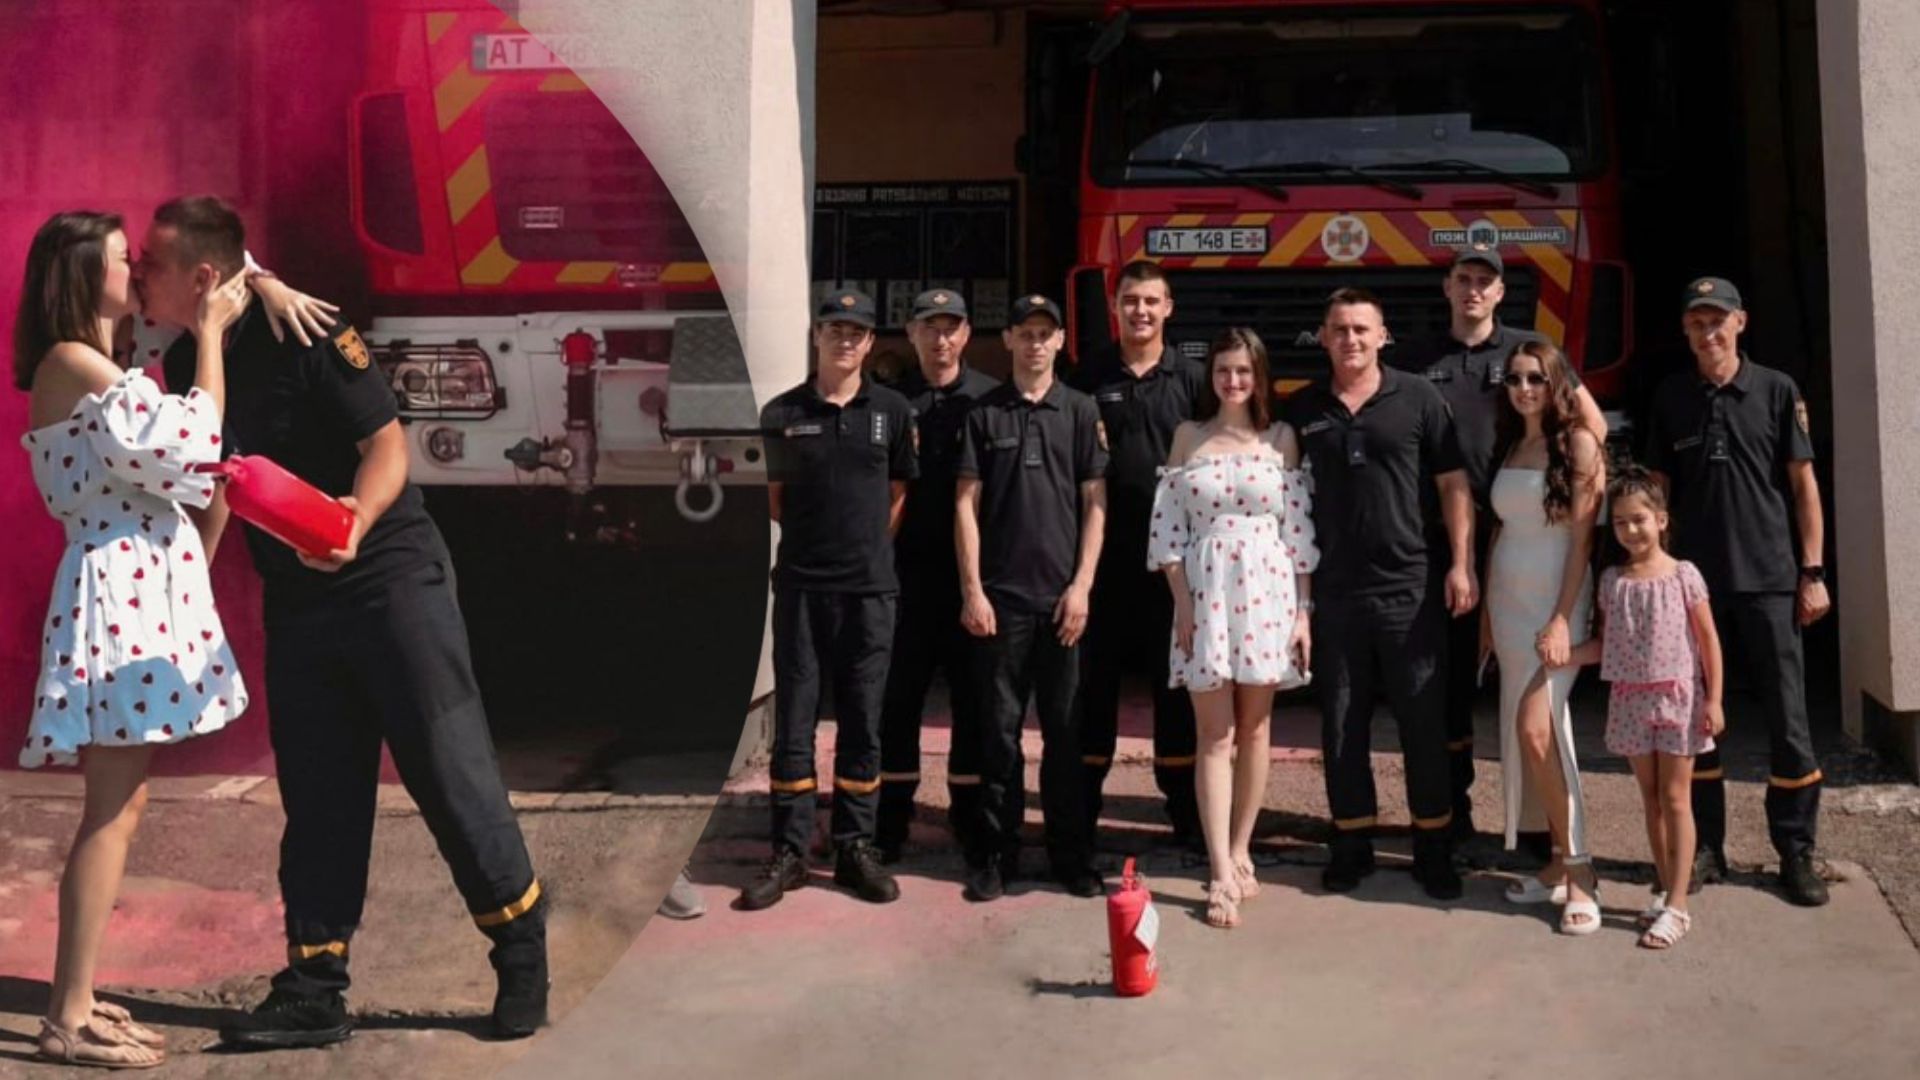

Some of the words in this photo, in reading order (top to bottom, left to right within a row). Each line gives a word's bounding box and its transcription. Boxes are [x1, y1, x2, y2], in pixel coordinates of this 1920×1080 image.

[489, 38, 529, 65] AT
[1159, 231, 1185, 250] AT
[1193, 231, 1225, 249] 148
[1231, 230, 1244, 249] E
[1500, 230, 1561, 242] МАШИНА
